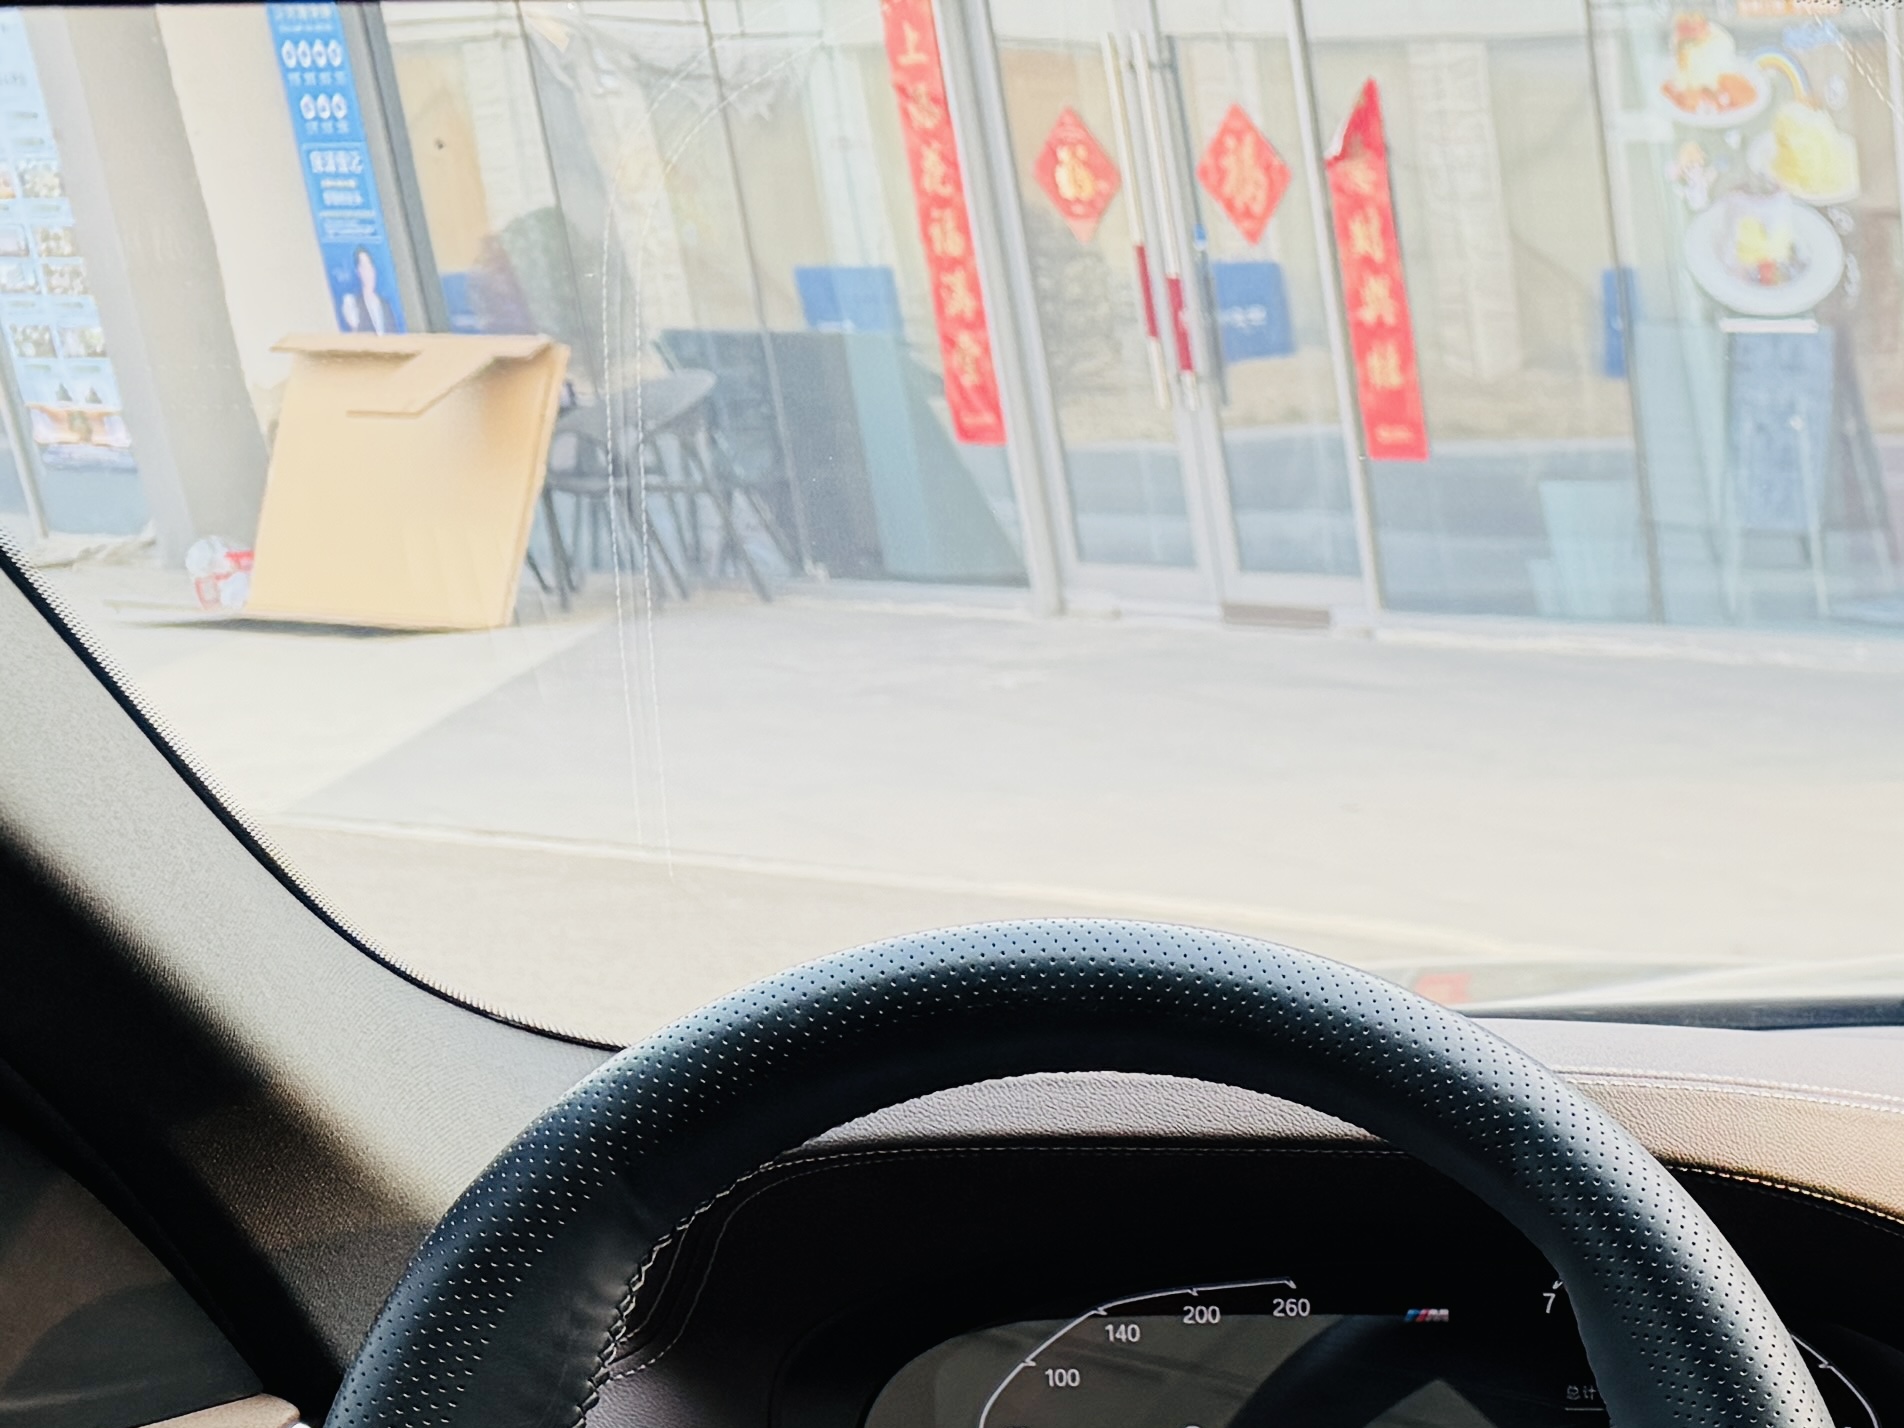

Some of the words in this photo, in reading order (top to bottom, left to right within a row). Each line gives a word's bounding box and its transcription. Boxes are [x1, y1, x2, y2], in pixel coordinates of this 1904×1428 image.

[1183, 1306, 1220, 1324] 200
[1273, 1298, 1310, 1317] 260
[1105, 1323, 1140, 1342] 140
[1045, 1368, 1080, 1387] 100
